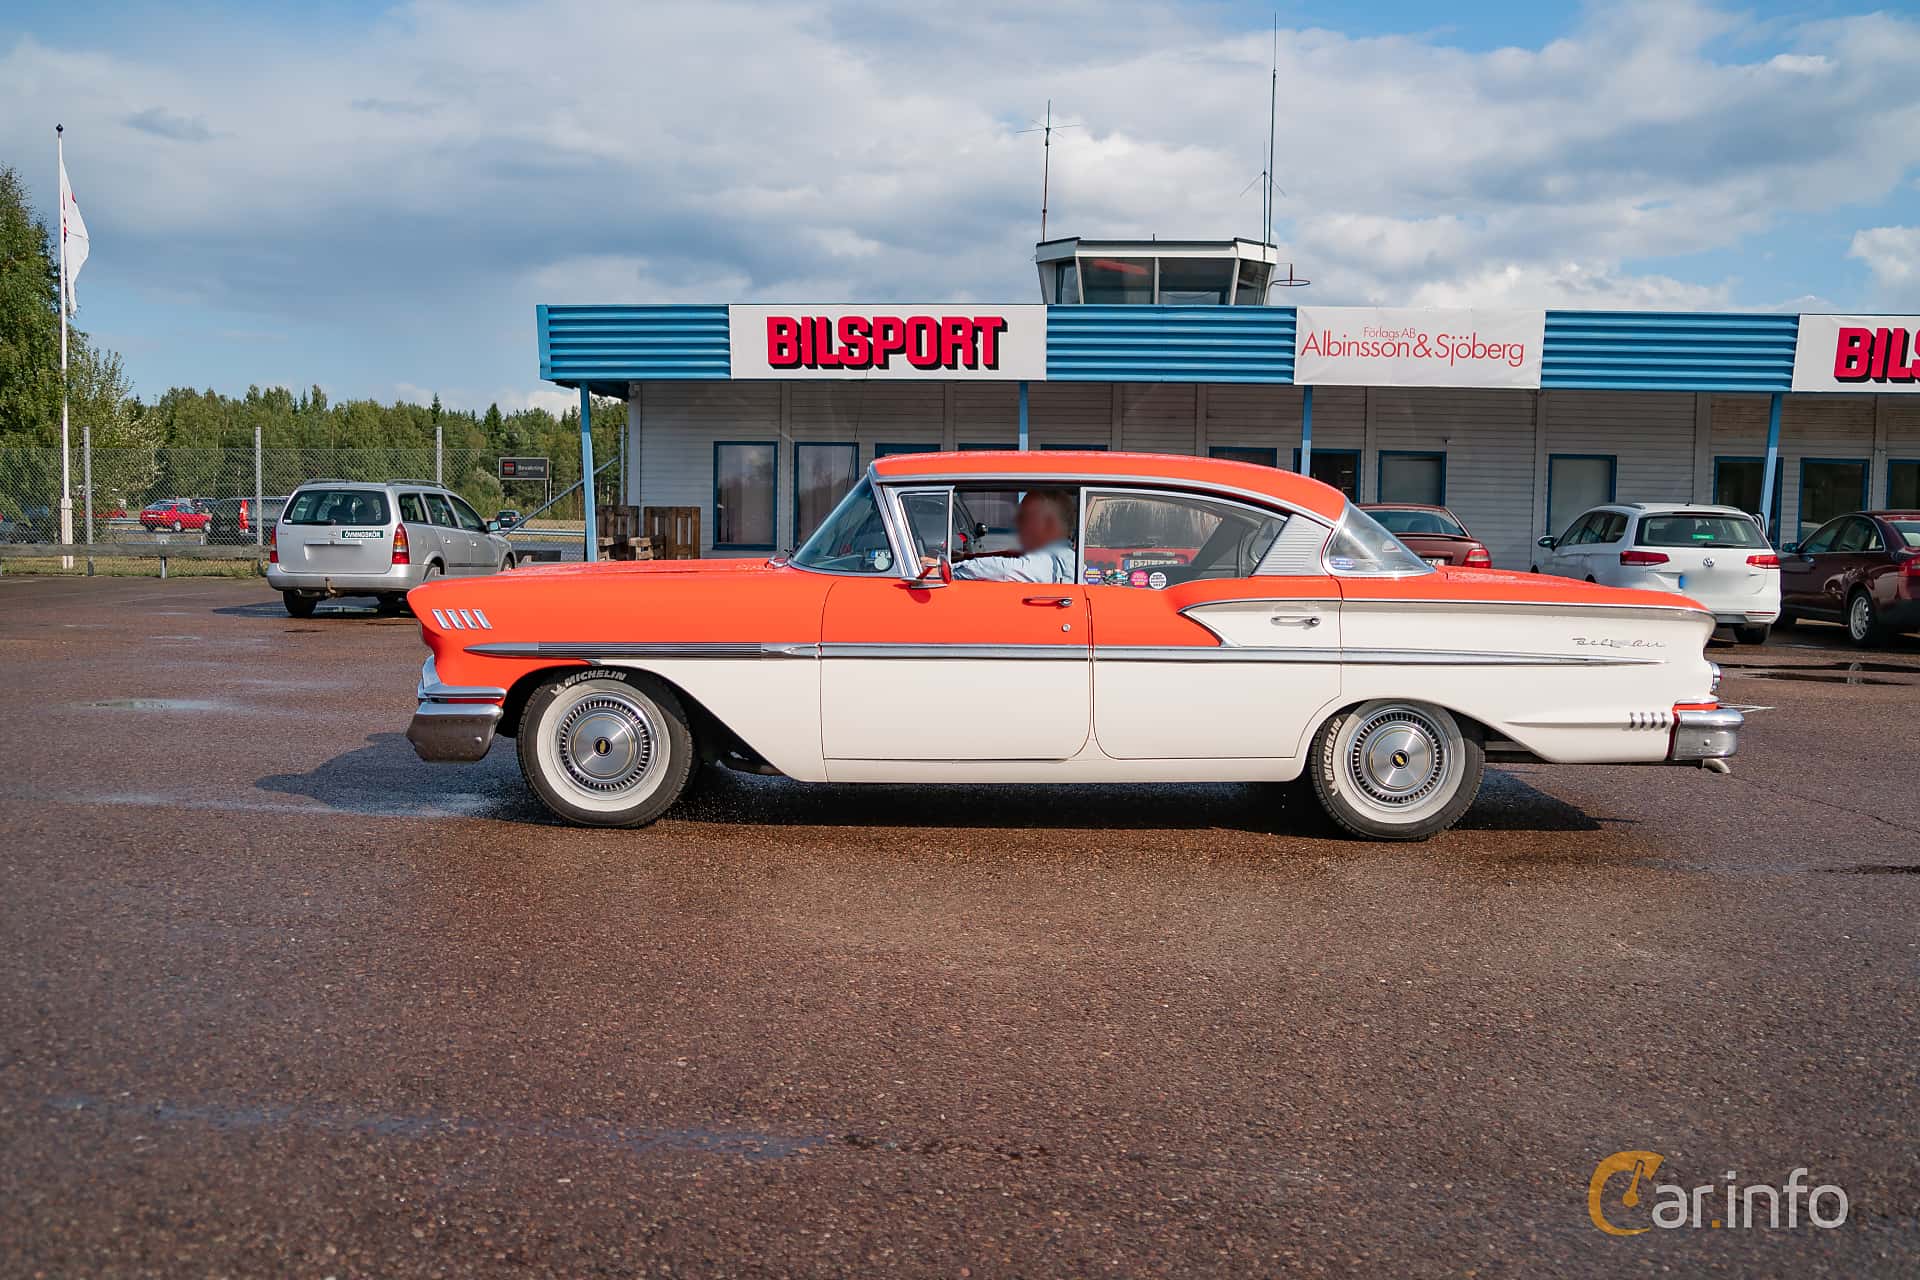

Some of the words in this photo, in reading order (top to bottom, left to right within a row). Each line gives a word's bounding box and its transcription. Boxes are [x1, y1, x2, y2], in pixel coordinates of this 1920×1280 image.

[767, 316, 1008, 370] BILSPORT
[1363, 326, 1400, 339] Förlags
[1401, 327, 1416, 338] AB
[1834, 327, 1920, 383] BIL
[564, 669, 627, 687] MICHELIN
[1323, 718, 1343, 781] MICHELIN
